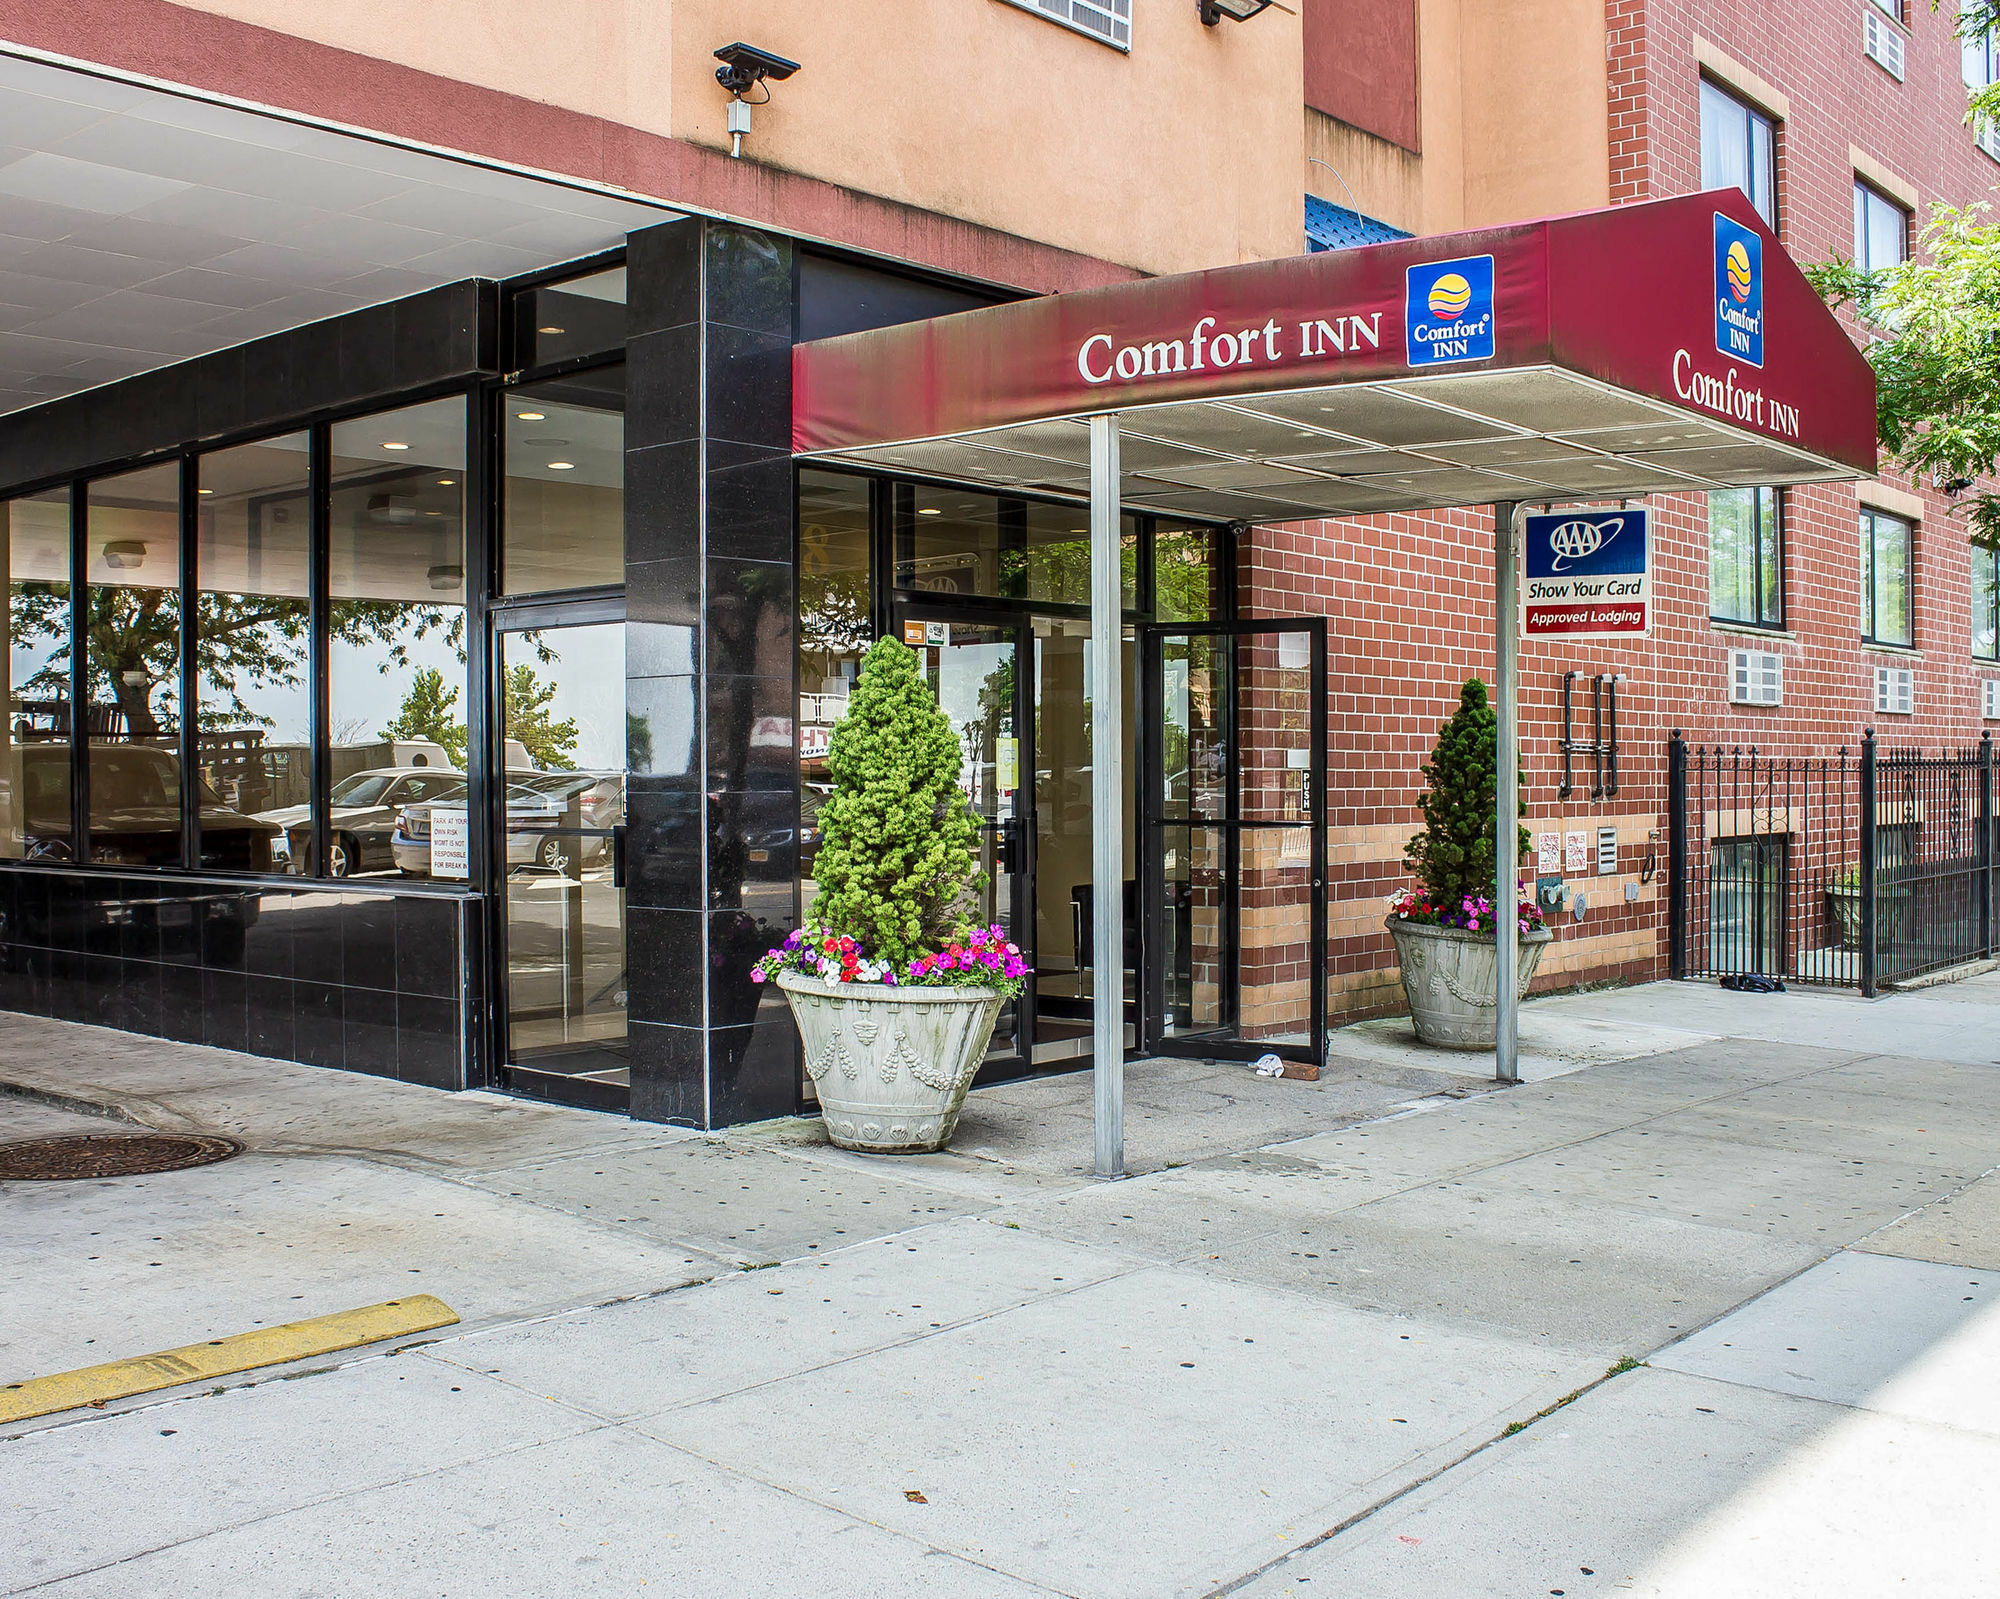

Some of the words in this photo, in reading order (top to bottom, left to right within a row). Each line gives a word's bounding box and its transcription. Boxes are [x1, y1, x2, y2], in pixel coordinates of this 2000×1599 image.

[1078, 317, 1282, 383] Comfort
[1299, 312, 1383, 357] INN
[1433, 339, 1468, 358] INN
[1730, 328, 1750, 354] INN
[1673, 349, 1763, 426] Comfort
[1769, 400, 1800, 438] INN
[1554, 522, 1599, 556] AAA
[1529, 582, 1569, 599] Show
[1573, 581, 1604, 597] Your
[1607, 578, 1642, 595] Card
[1530, 611, 1588, 626] Approved
[1591, 609, 1641, 624] Lodging
